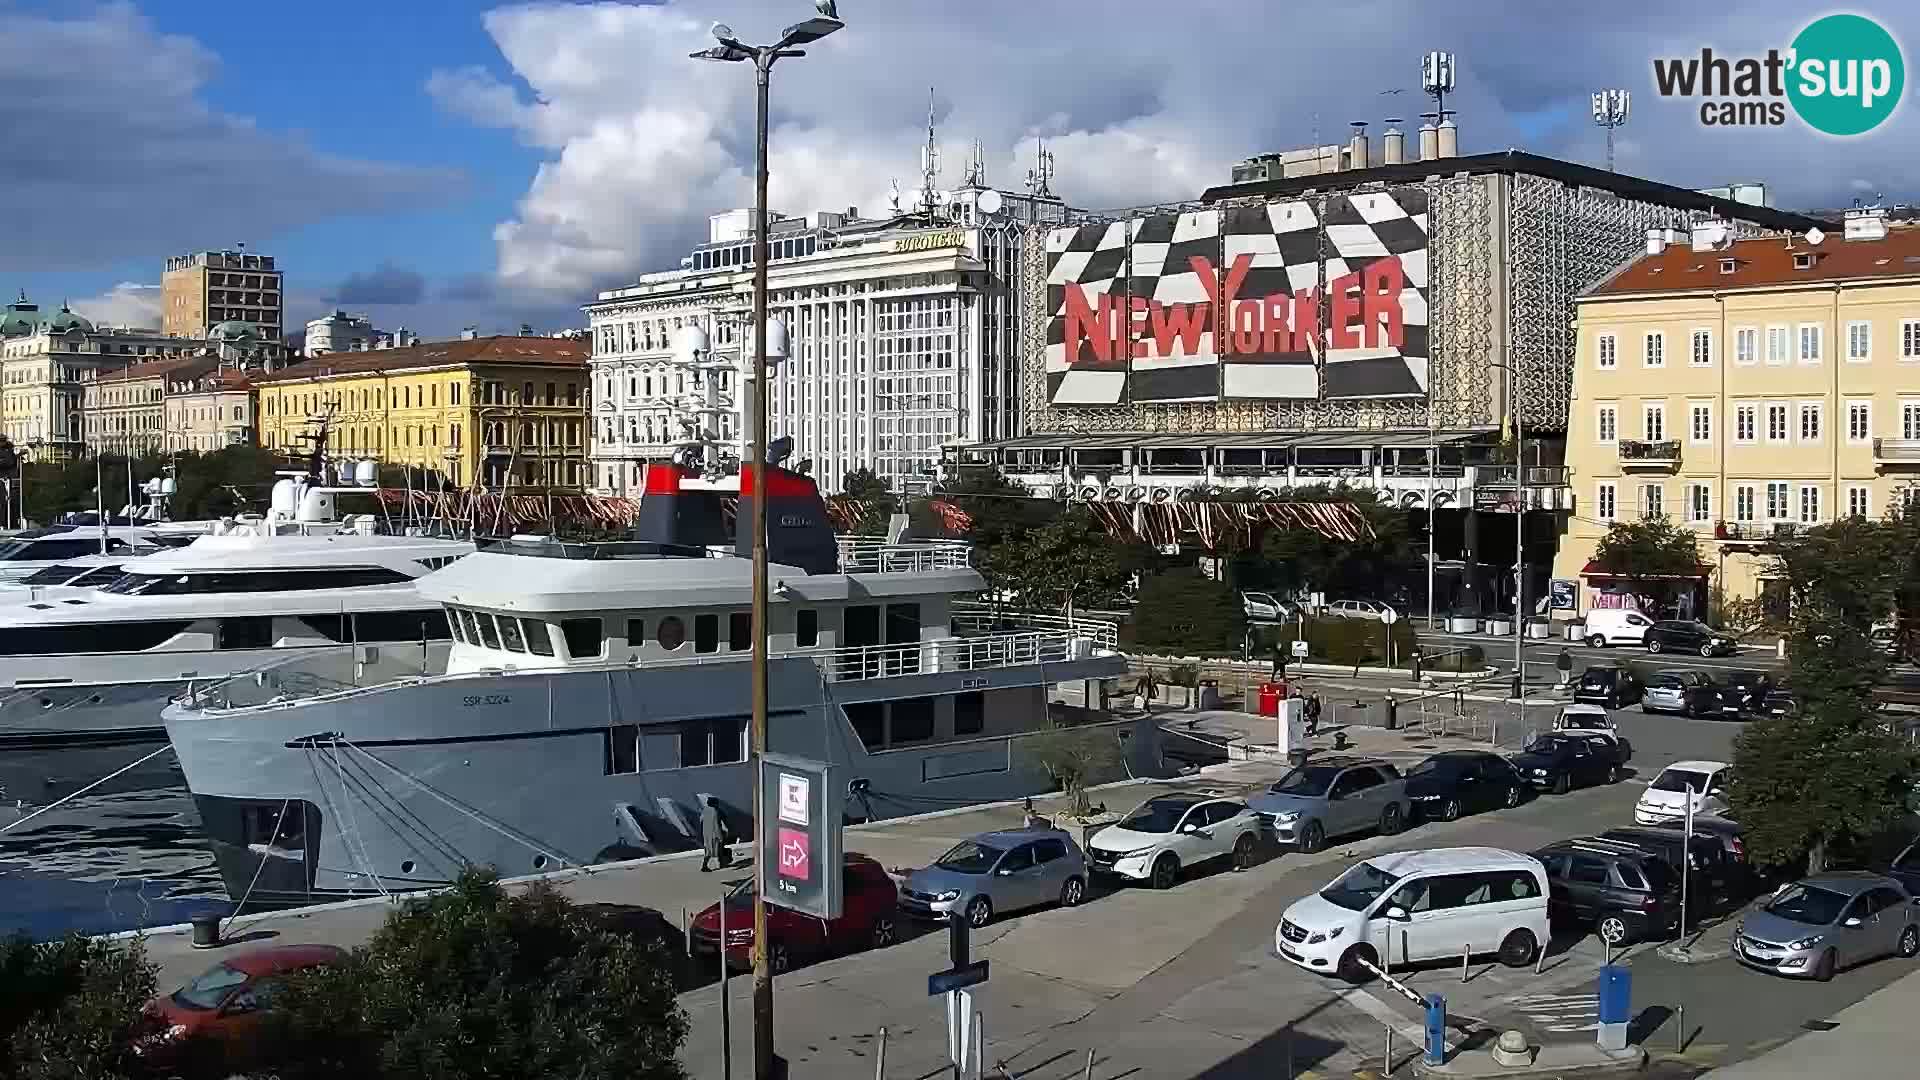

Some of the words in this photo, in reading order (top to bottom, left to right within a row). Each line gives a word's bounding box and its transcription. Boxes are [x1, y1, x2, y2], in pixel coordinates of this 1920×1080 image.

[1064, 279, 1208, 363] NEW
[1187, 252, 1404, 355] YORKER
[779, 879, 785, 890] 5
